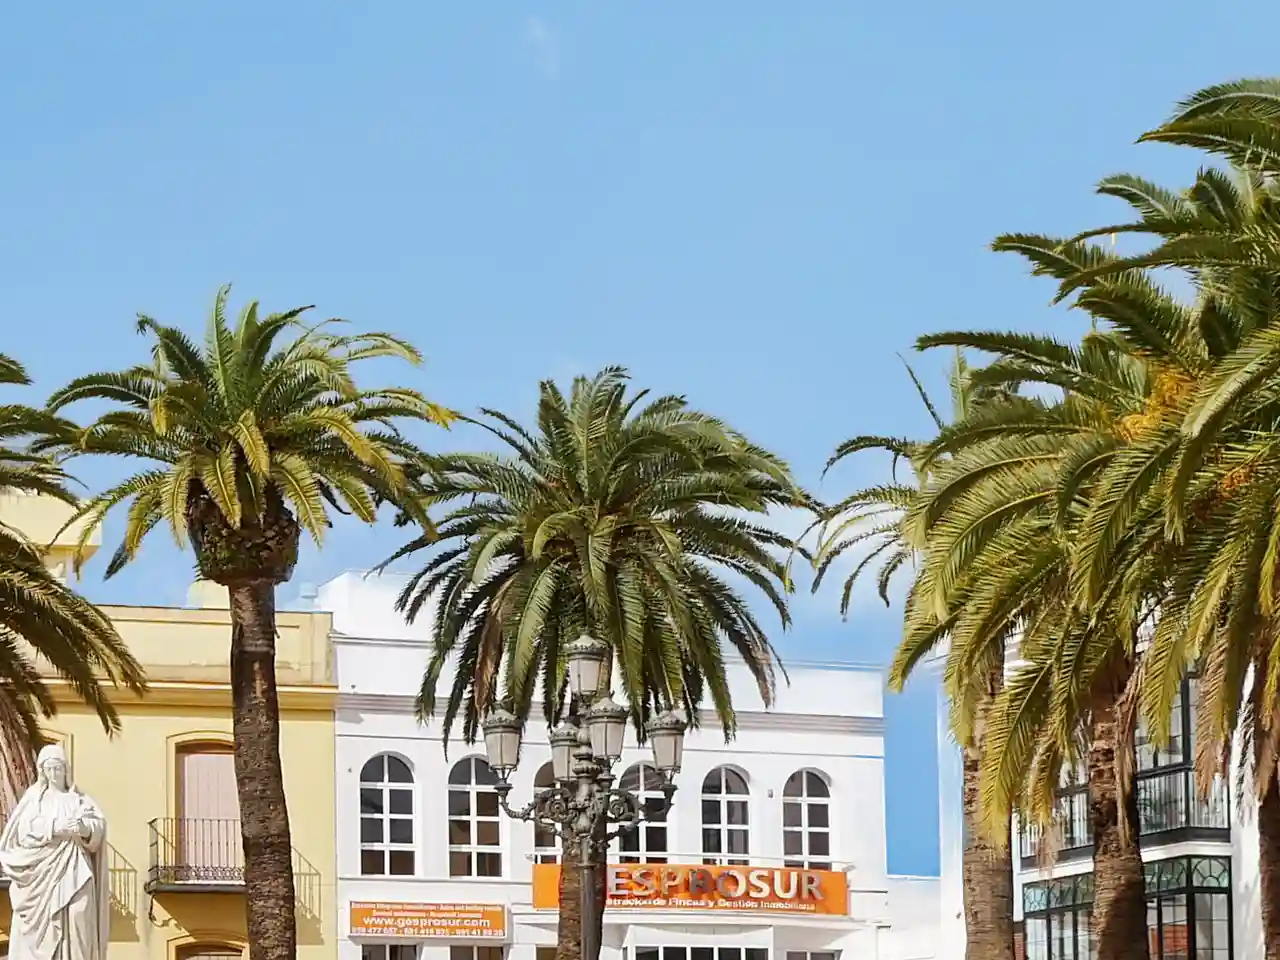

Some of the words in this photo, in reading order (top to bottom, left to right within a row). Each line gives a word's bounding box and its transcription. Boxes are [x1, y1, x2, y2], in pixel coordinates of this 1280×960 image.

[606, 867, 824, 901] ESPROSUR
[669, 898, 705, 907] Fincas
[708, 899, 715, 909] y
[720, 899, 758, 908] Gestión
[362, 917, 491, 929] www.gesprosur.com
